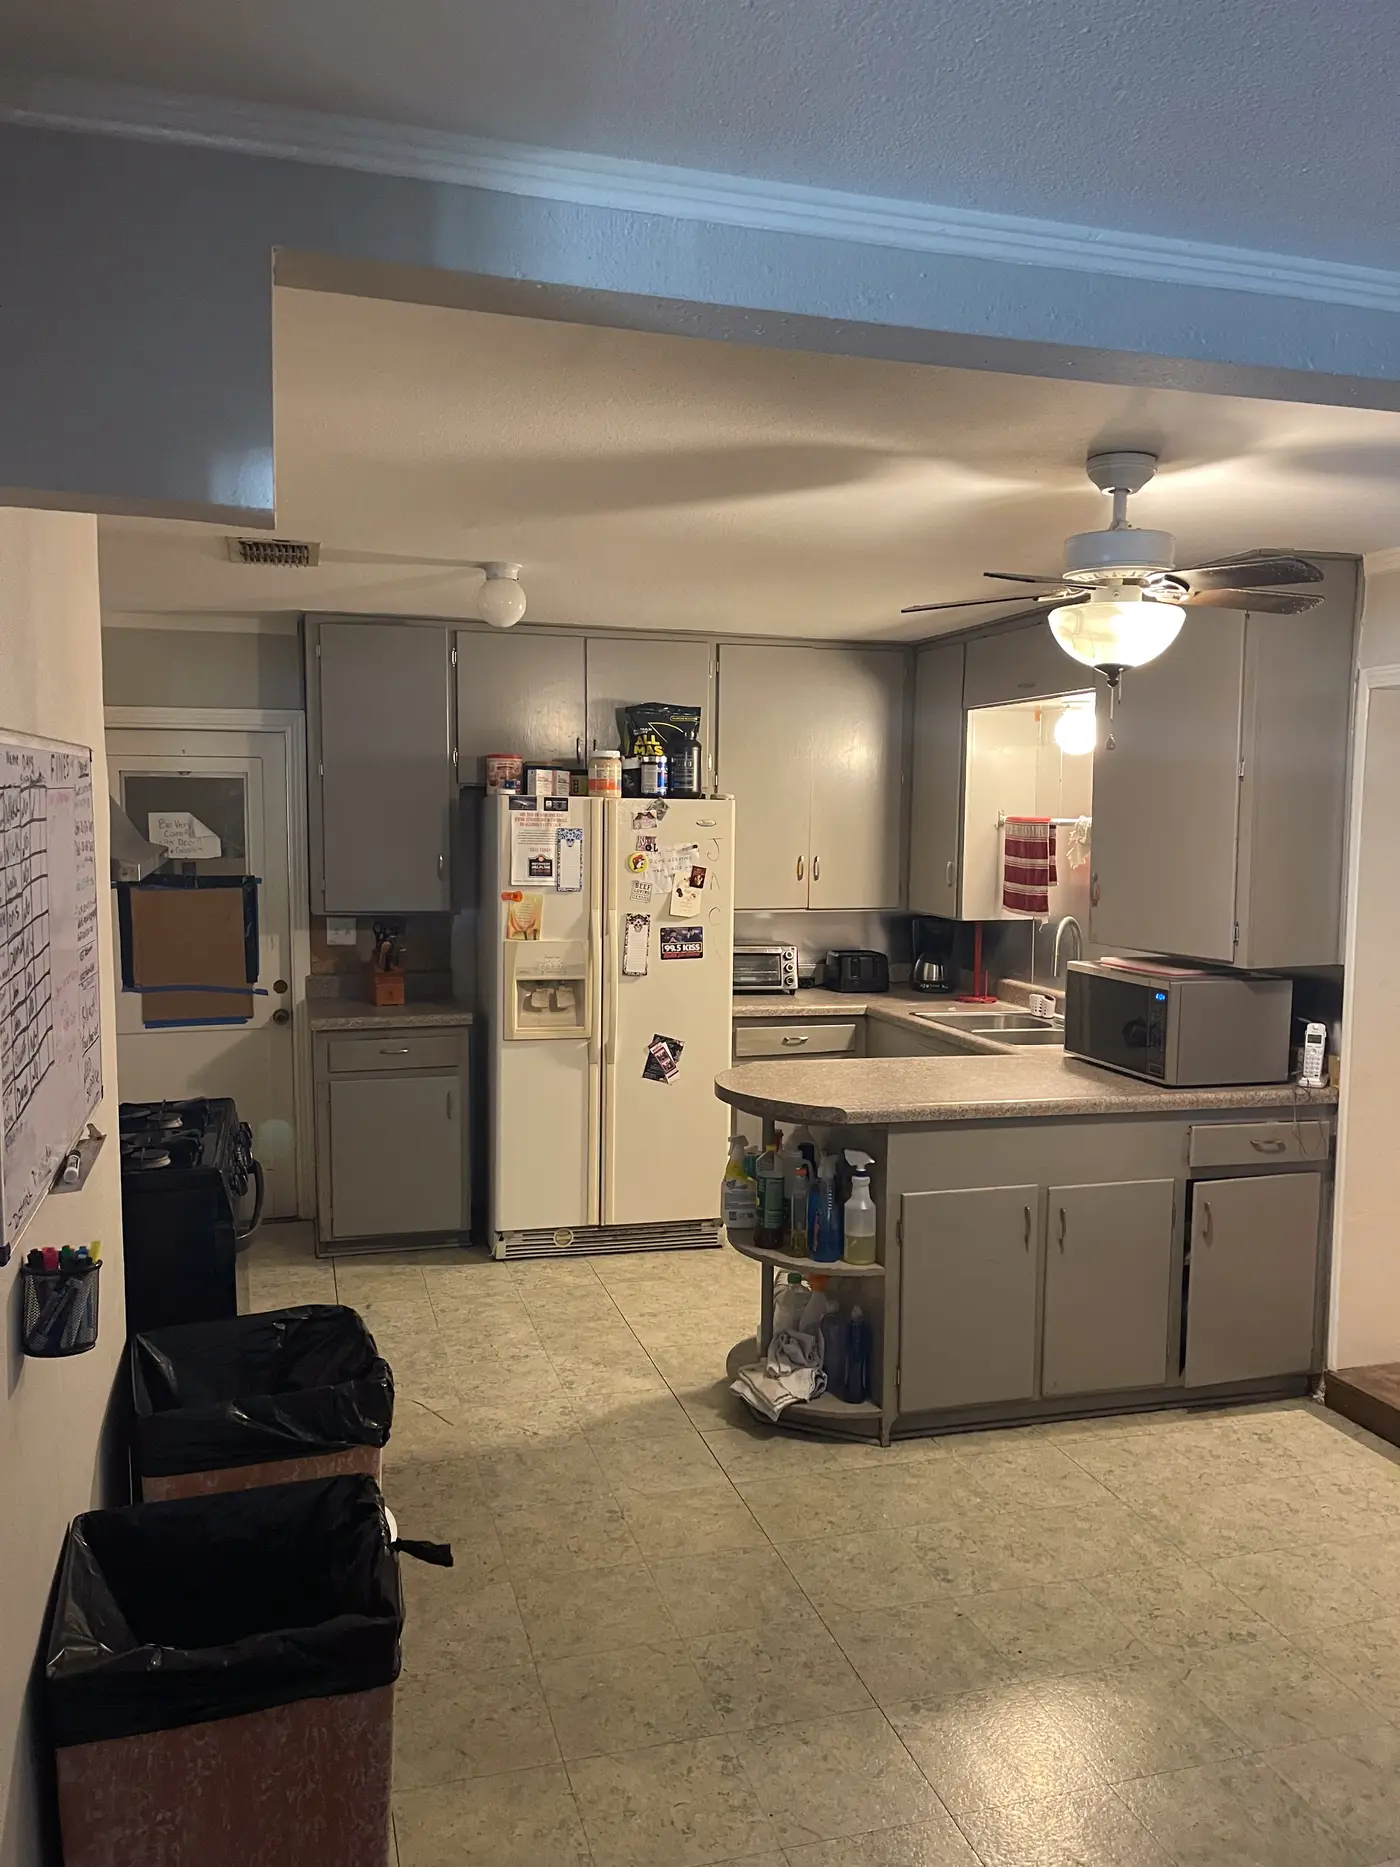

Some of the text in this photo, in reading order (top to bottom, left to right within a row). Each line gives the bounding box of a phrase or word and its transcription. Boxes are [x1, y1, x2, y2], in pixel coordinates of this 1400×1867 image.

[636, 734, 660, 746] ALL
[634, 882, 651, 891] BEEF
[664, 943, 701, 952] 99.5 KISS
